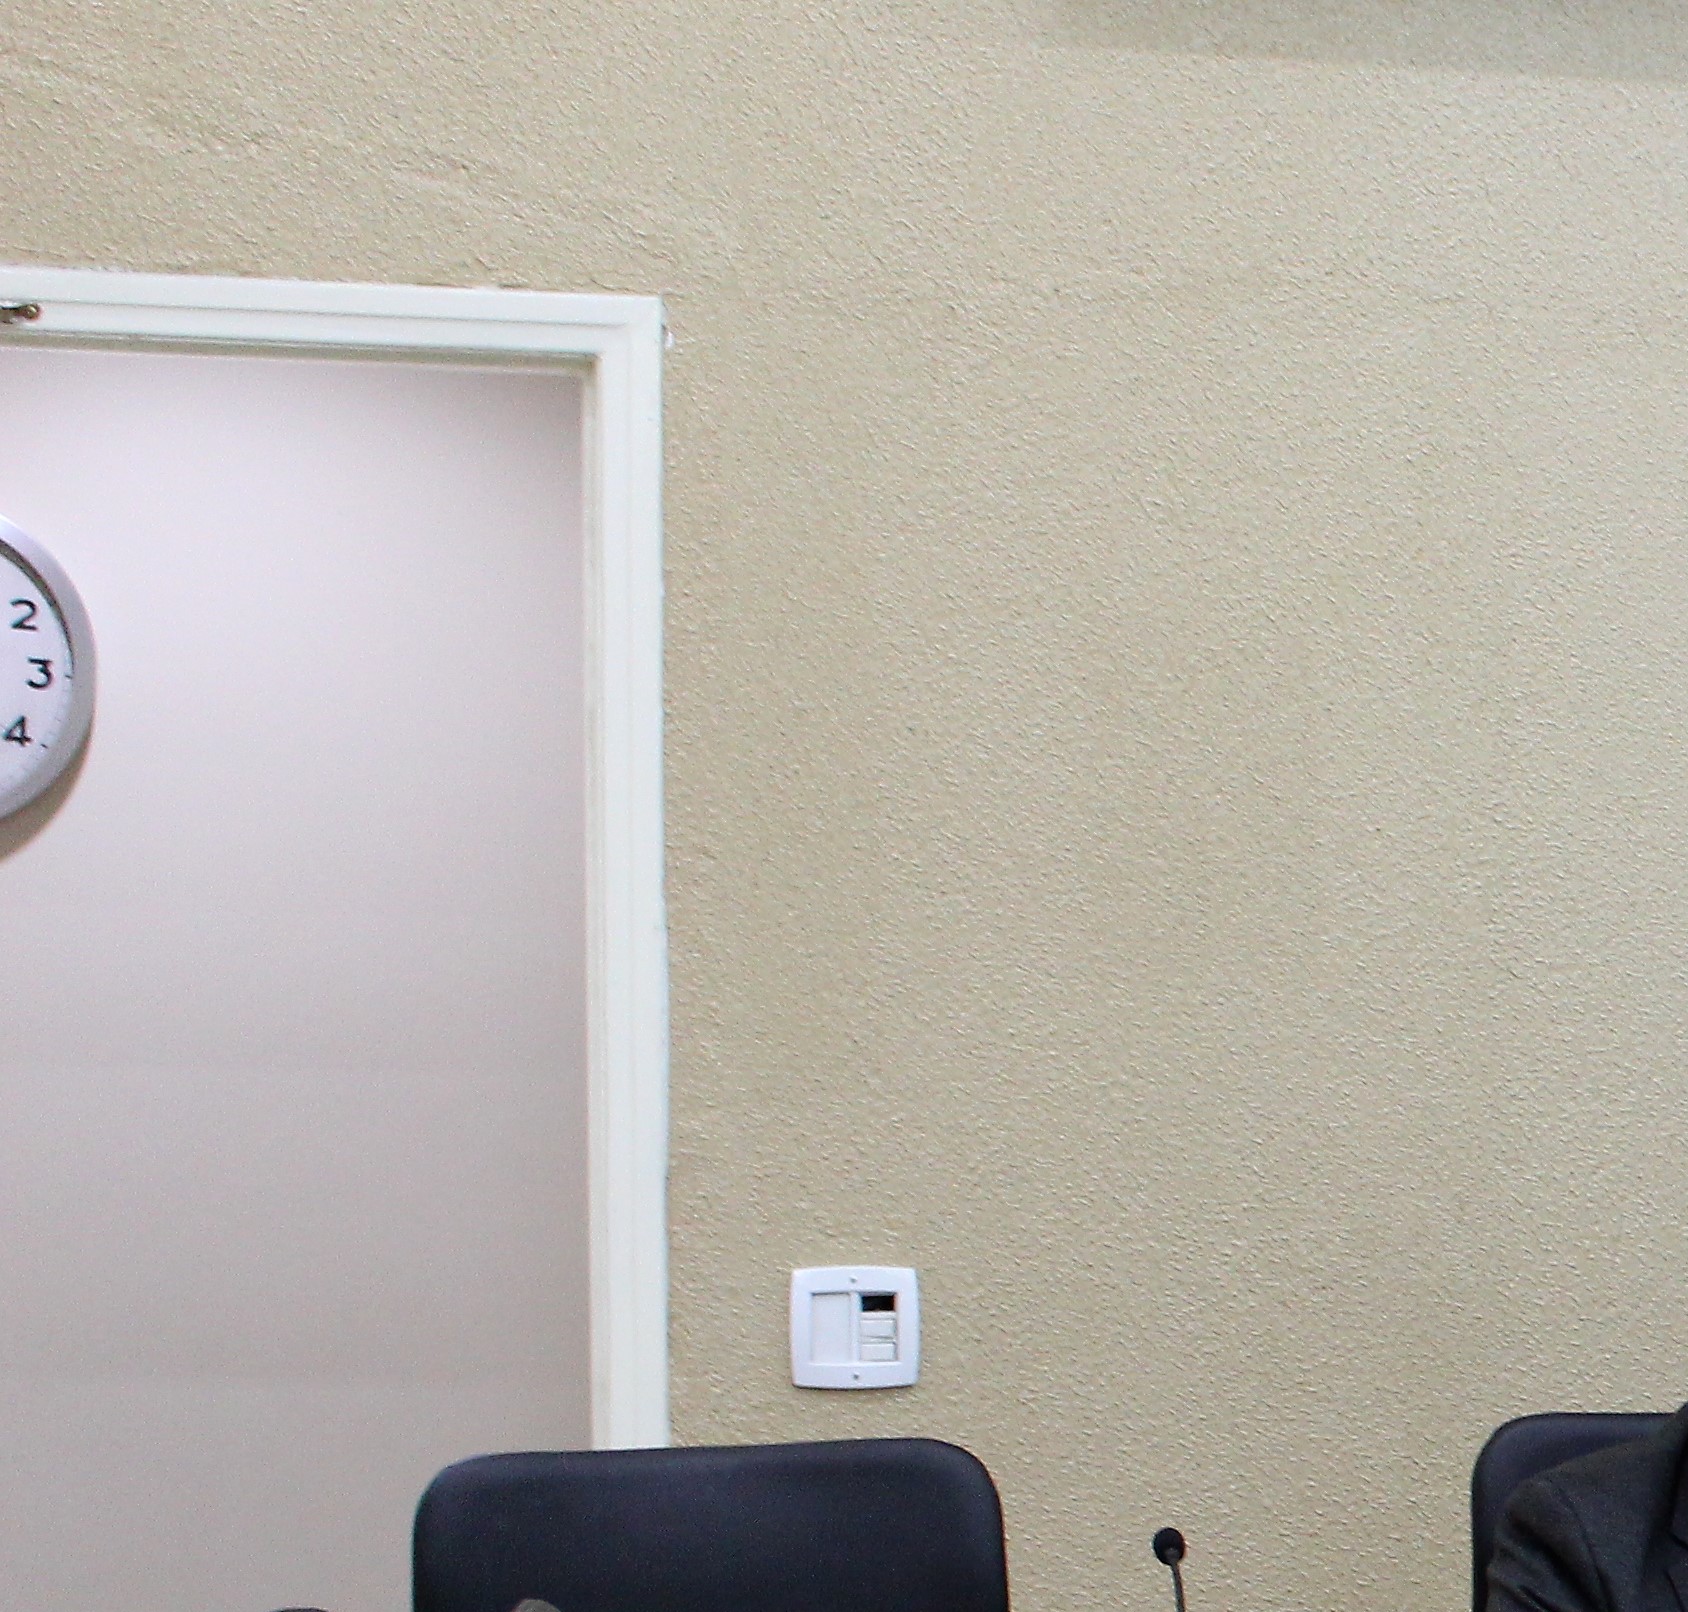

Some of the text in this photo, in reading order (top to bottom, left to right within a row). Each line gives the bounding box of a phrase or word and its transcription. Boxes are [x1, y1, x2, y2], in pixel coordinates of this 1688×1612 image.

[10, 599, 38, 631] 2
[27, 657, 54, 689] 3
[4, 715, 33, 748] 4
